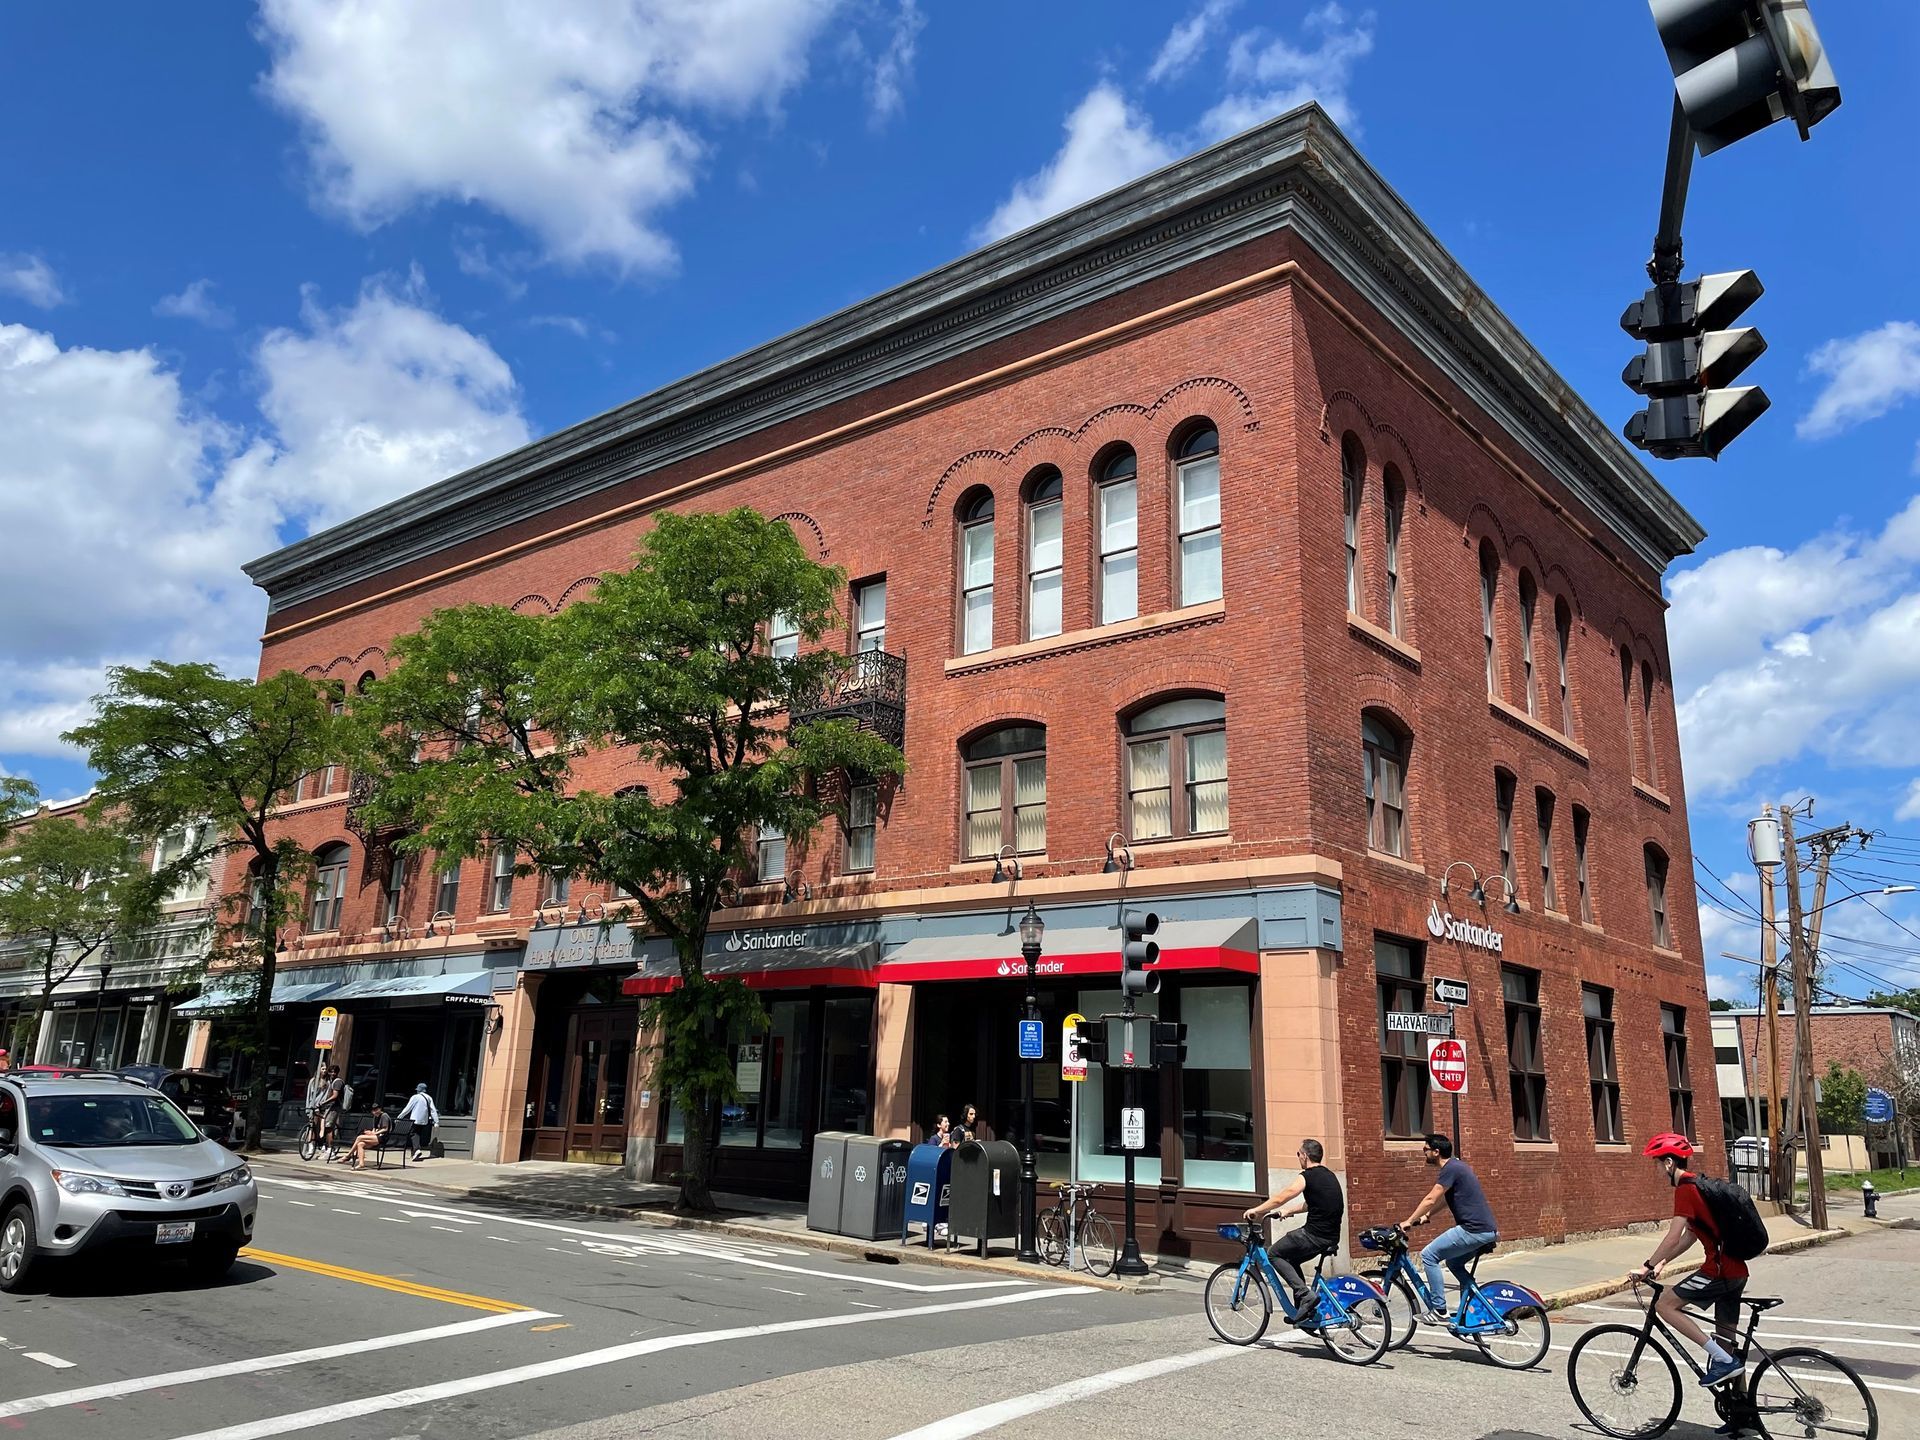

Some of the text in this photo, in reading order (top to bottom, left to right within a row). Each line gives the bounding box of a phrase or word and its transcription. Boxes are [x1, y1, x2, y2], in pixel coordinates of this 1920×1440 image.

[571, 928, 594, 944] ONE
[1444, 913, 1503, 951] Santander
[742, 931, 807, 951] Santander
[530, 943, 632, 965] HARVARD STREET
[1443, 986, 1465, 999] ONE WAY
[1389, 1015, 1428, 1031] HARVAR
[1429, 1018, 1442, 1032] KENT
[1436, 1049, 1462, 1058] DO NOT
[1440, 1073, 1462, 1082] ENTER
